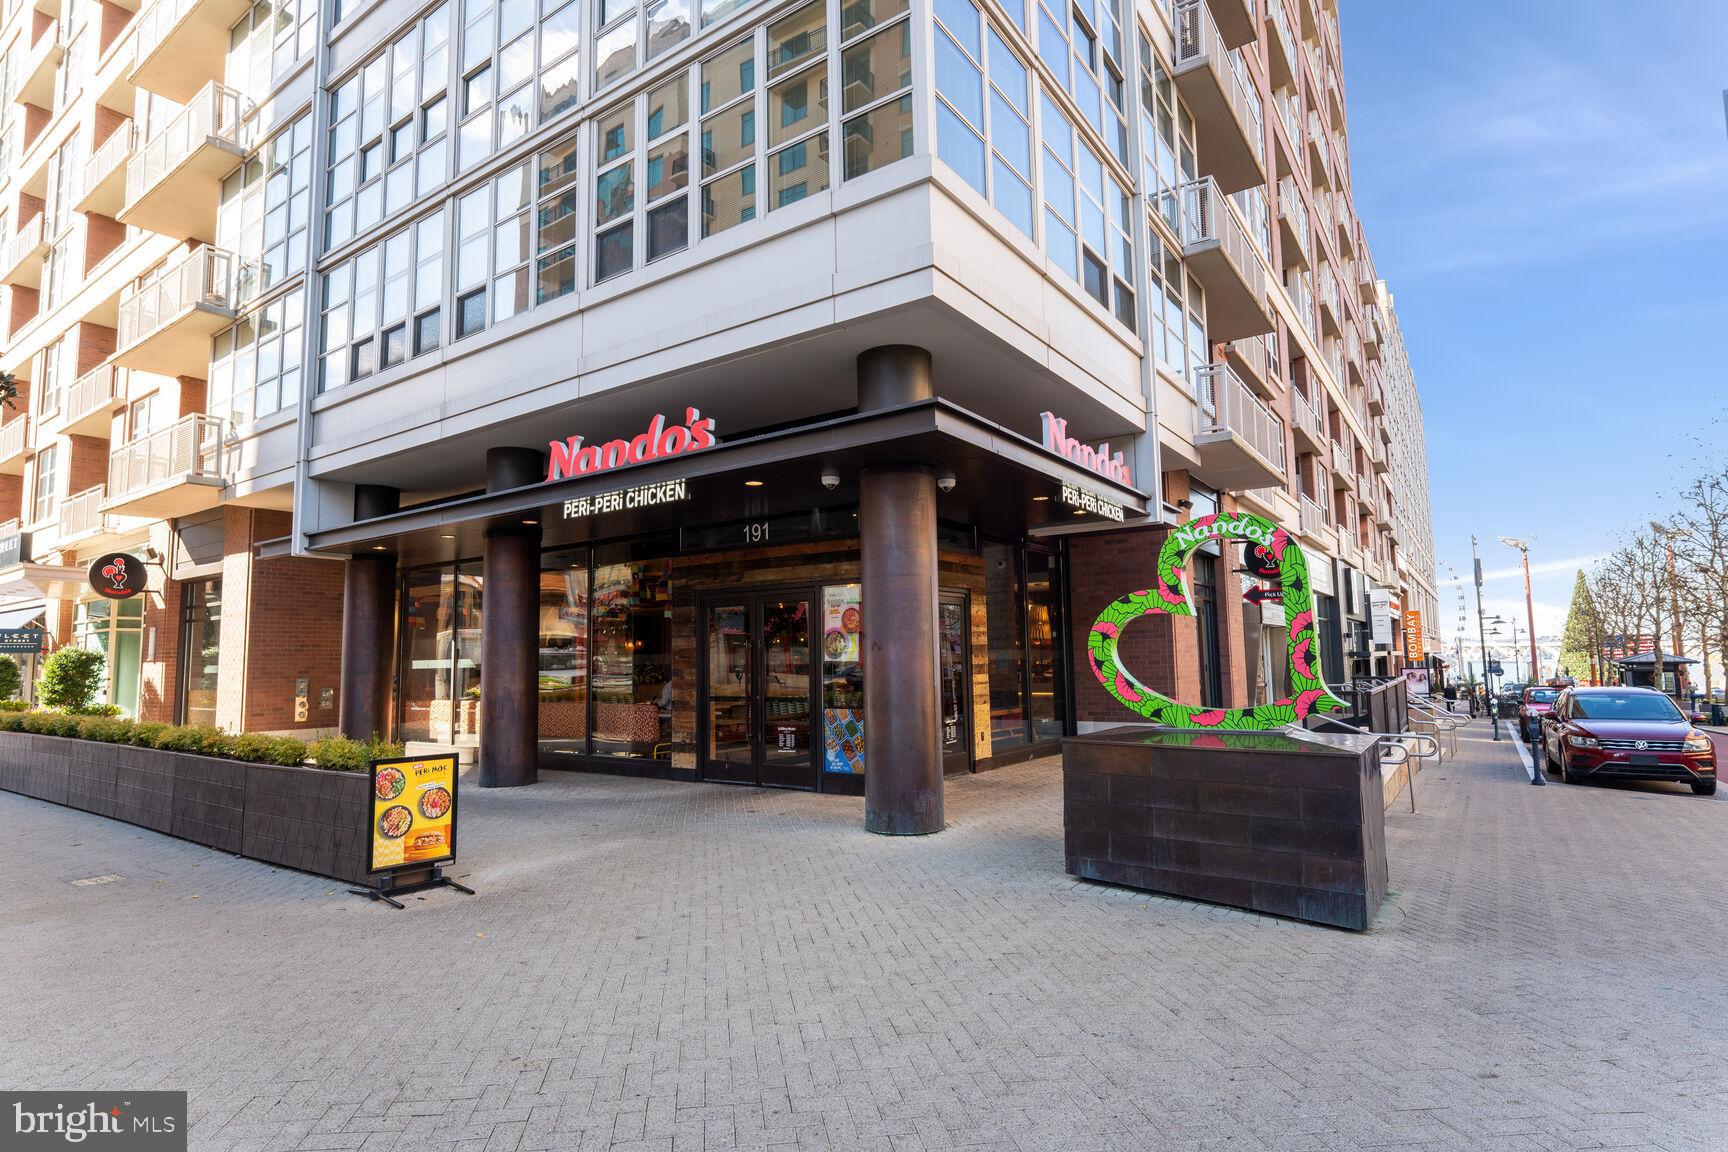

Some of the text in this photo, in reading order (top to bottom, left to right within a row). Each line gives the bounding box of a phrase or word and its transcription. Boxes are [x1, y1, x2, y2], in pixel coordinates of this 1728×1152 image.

[544, 406, 716, 483] Nando's
[1040, 411, 1134, 488] Nando's
[563, 481, 686, 519] PERi-PERi CHICKEN
[1097, 500, 1125, 522] CHICKEN
[743, 522, 769, 542] 191
[1174, 516, 1276, 549] Nando's
[1407, 614, 1418, 658] BOMBAY
